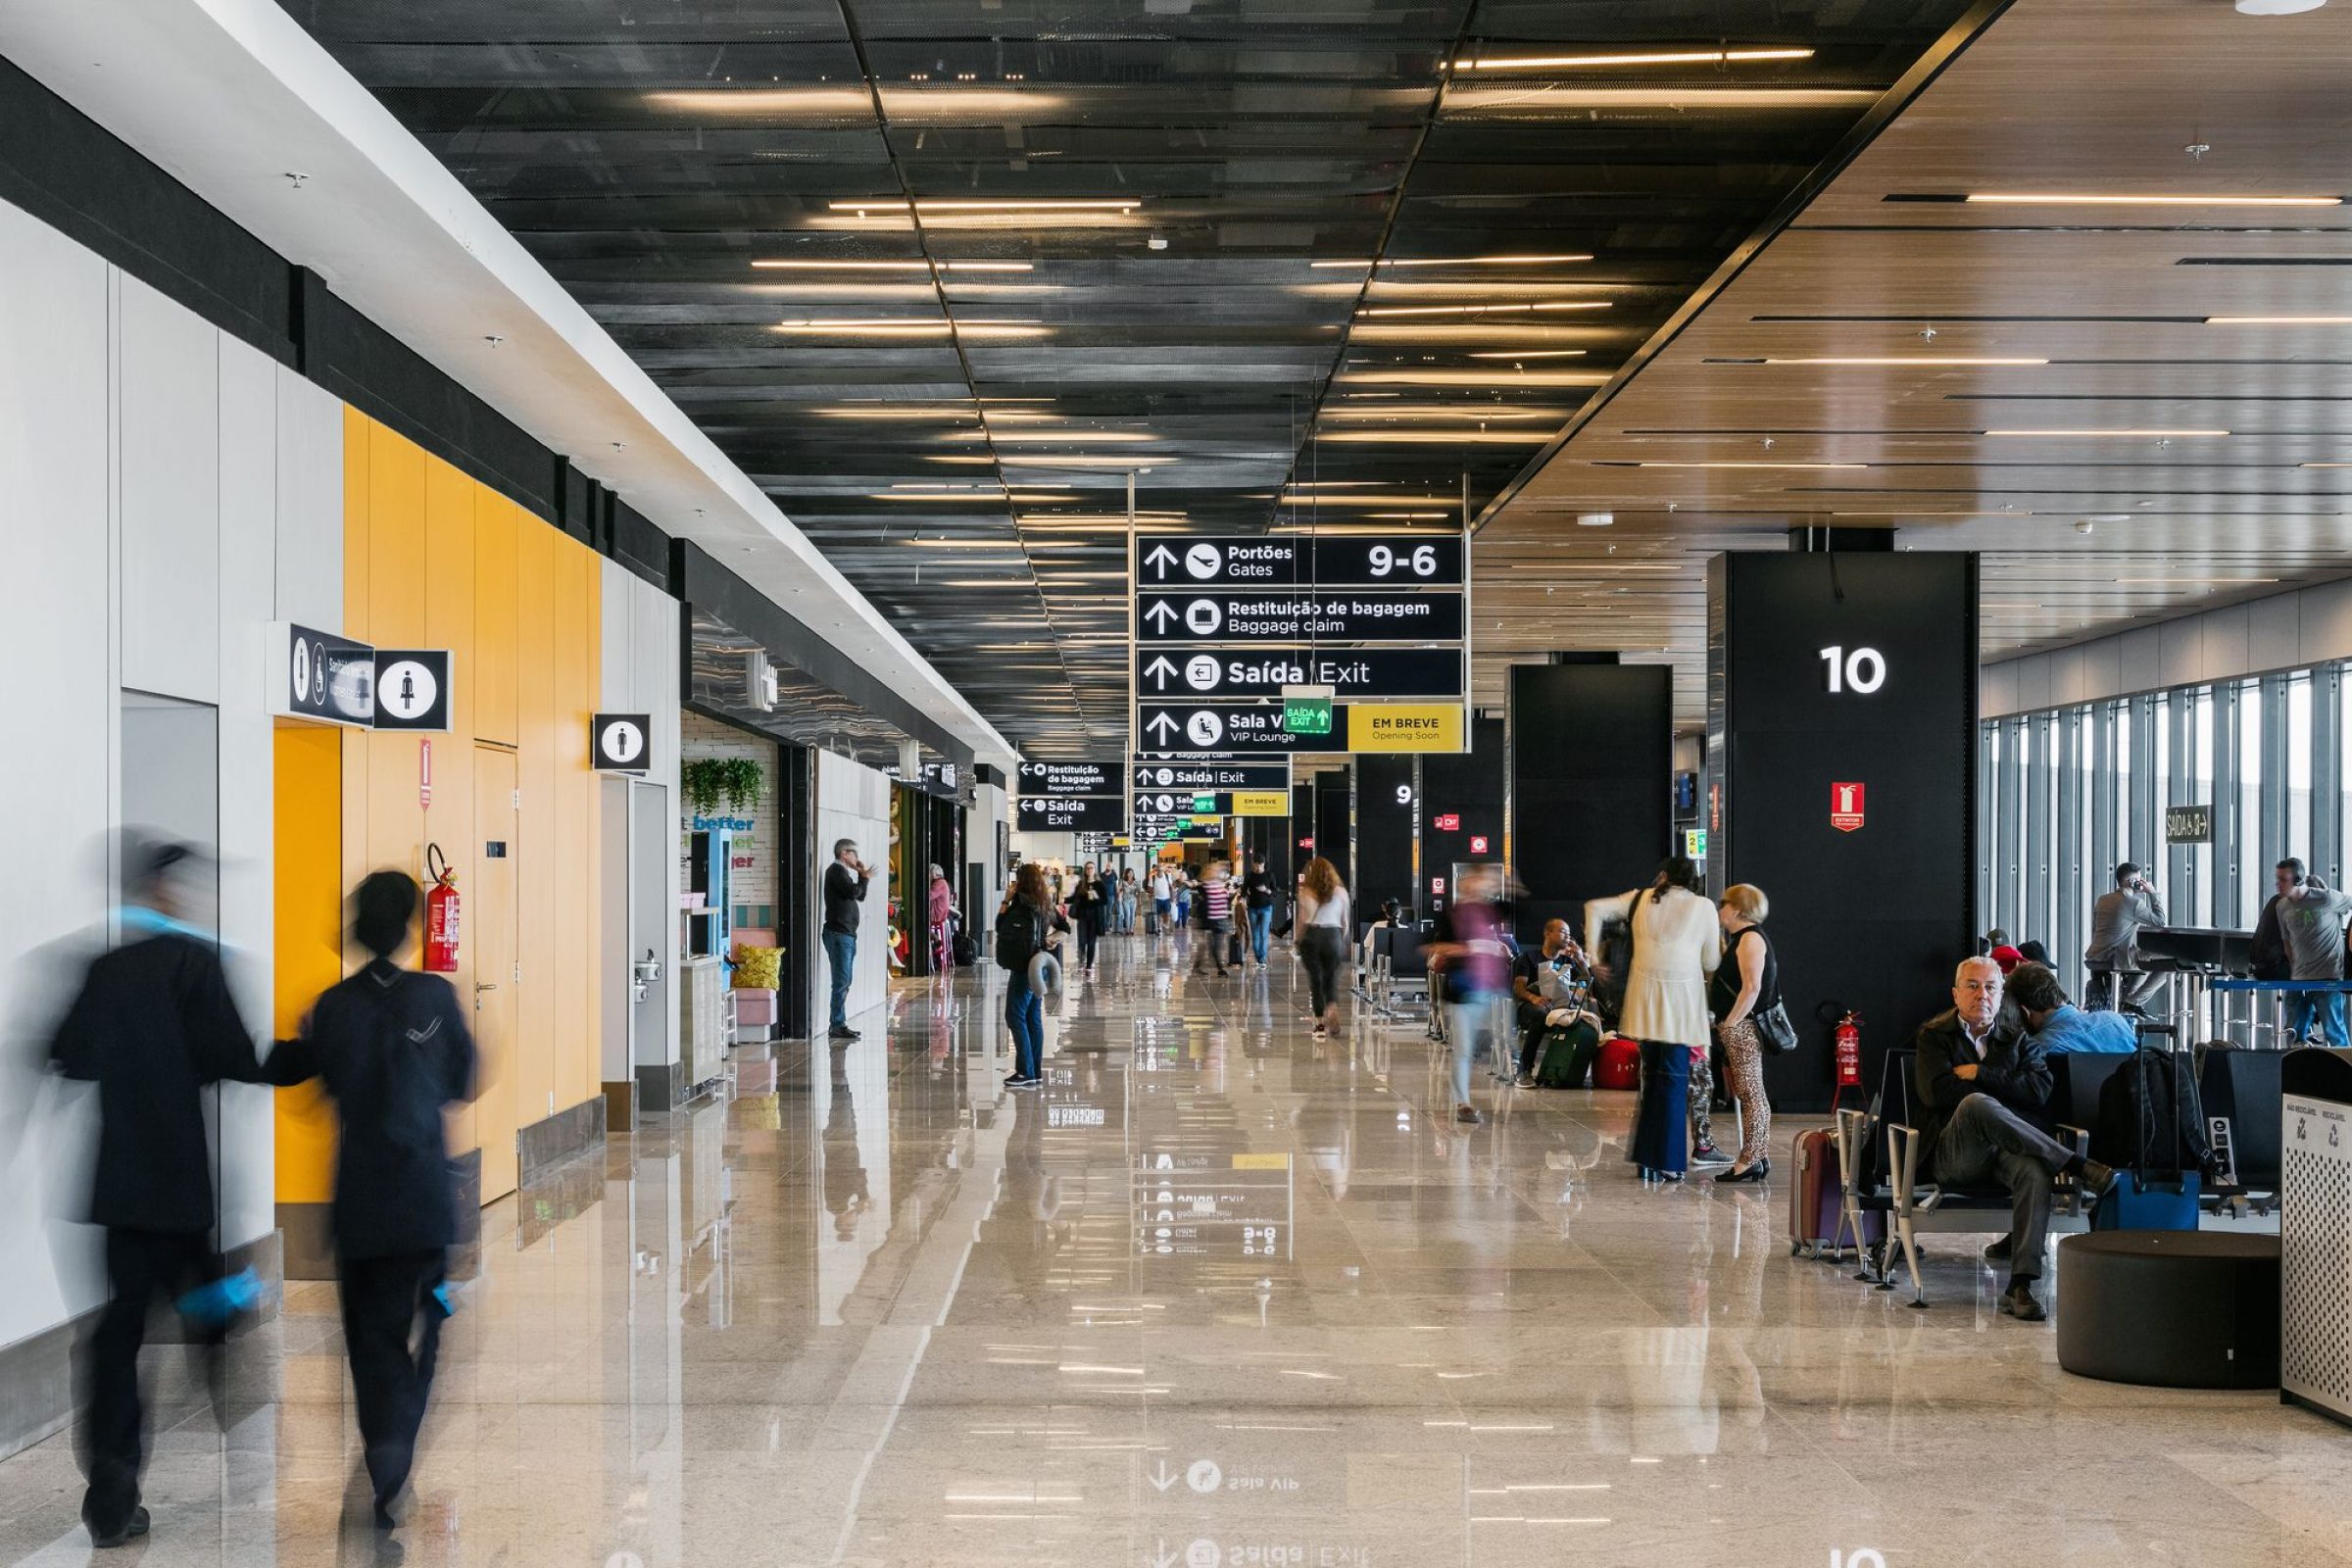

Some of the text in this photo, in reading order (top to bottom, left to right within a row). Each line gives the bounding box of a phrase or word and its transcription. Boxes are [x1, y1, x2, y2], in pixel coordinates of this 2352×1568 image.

[1228, 545, 1437, 576] Portões 9-6
[1228, 564, 1273, 576] Gates
[1228, 602, 1430, 619] Restituição de bagagem
[1229, 619, 1345, 634] Baggage claim
[1228, 662, 1370, 684] Saída Exit
[1820, 646, 1886, 694] 10
[1287, 706, 1315, 717] SAÍDA
[1229, 713, 1265, 728] Sala
[1291, 716, 1311, 726] EXIT
[1372, 717, 1440, 728] EM BREVE
[1230, 732, 1296, 744] VIP Lounge
[1372, 731, 1440, 741] Opening Soon
[1048, 764, 1100, 775] Restituição
[1061, 775, 1104, 784] bagagem
[1176, 771, 1245, 783] Saída Exit
[1396, 785, 1412, 805] 9
[1048, 799, 1086, 811] Saída
[693, 815, 755, 831] better
[1048, 813, 1073, 825] Exit
[2167, 809, 2187, 837] SAÍDA
